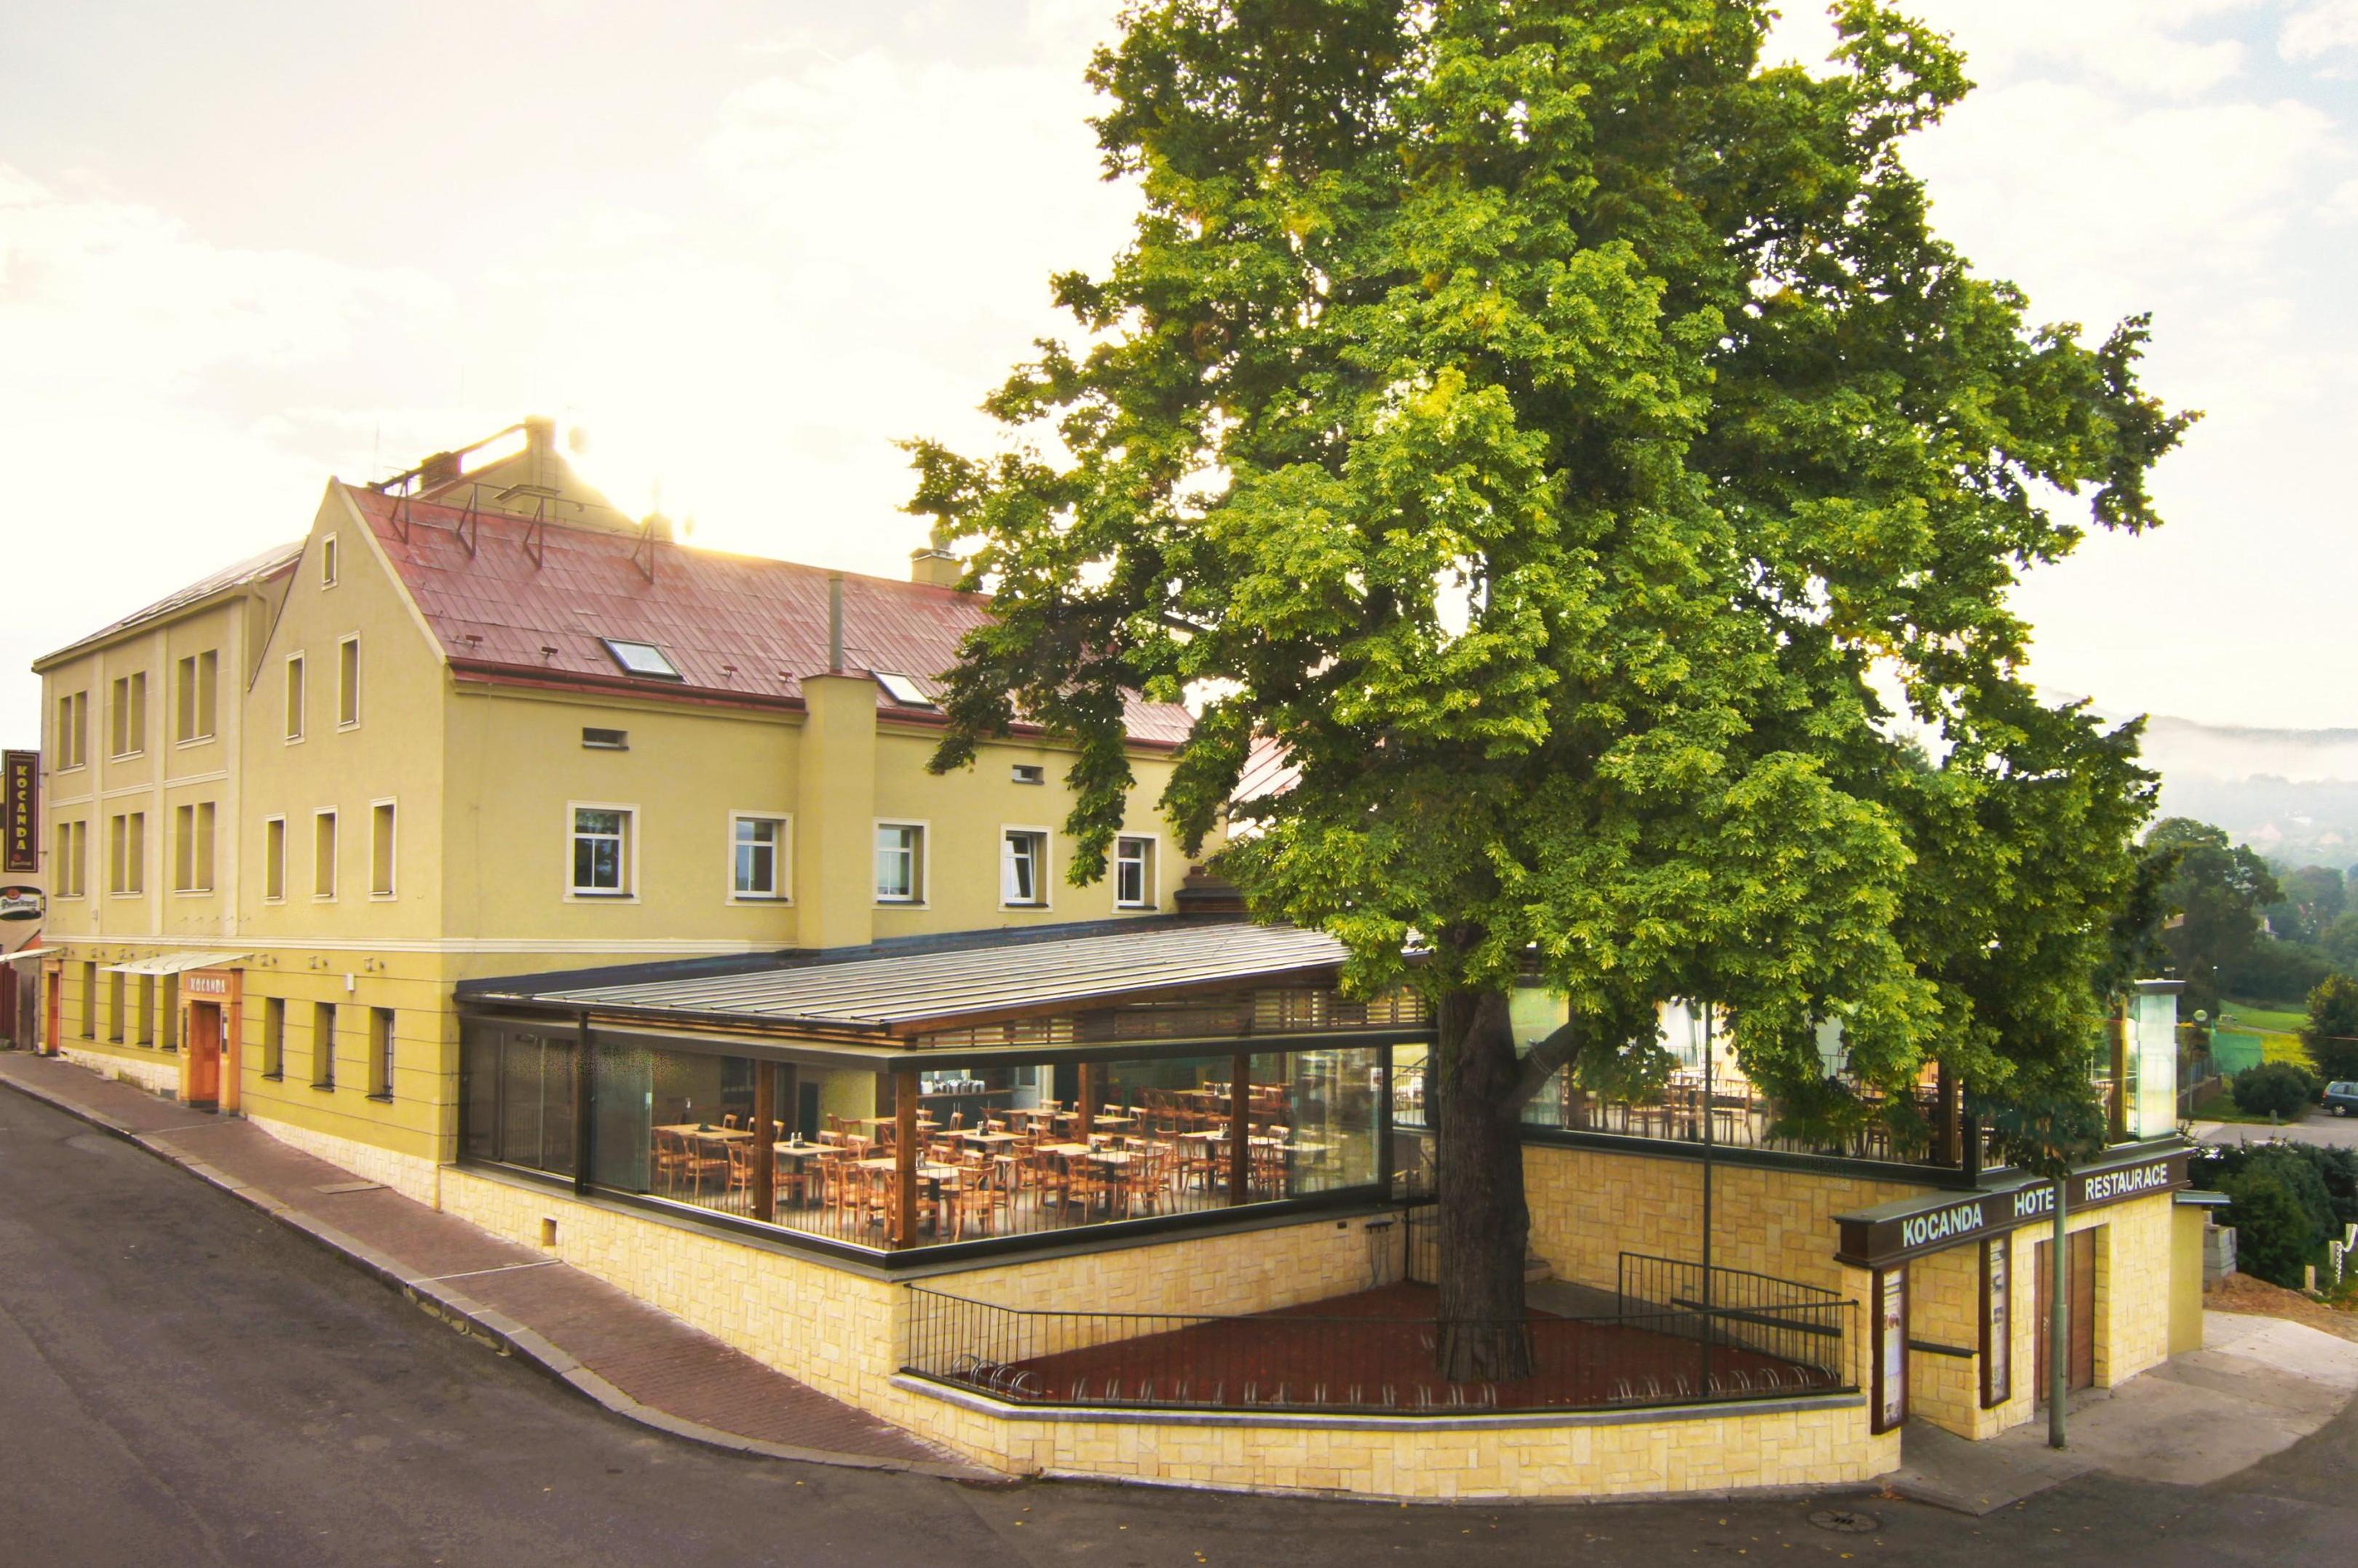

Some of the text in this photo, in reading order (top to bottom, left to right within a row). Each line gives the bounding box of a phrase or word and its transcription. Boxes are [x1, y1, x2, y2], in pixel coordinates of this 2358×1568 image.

[16, 765, 28, 850] KOCANDA
[190, 978, 226, 993] KOCANDA
[1903, 1163, 2168, 1248] KOCANDA HOTE RESTAURACE
